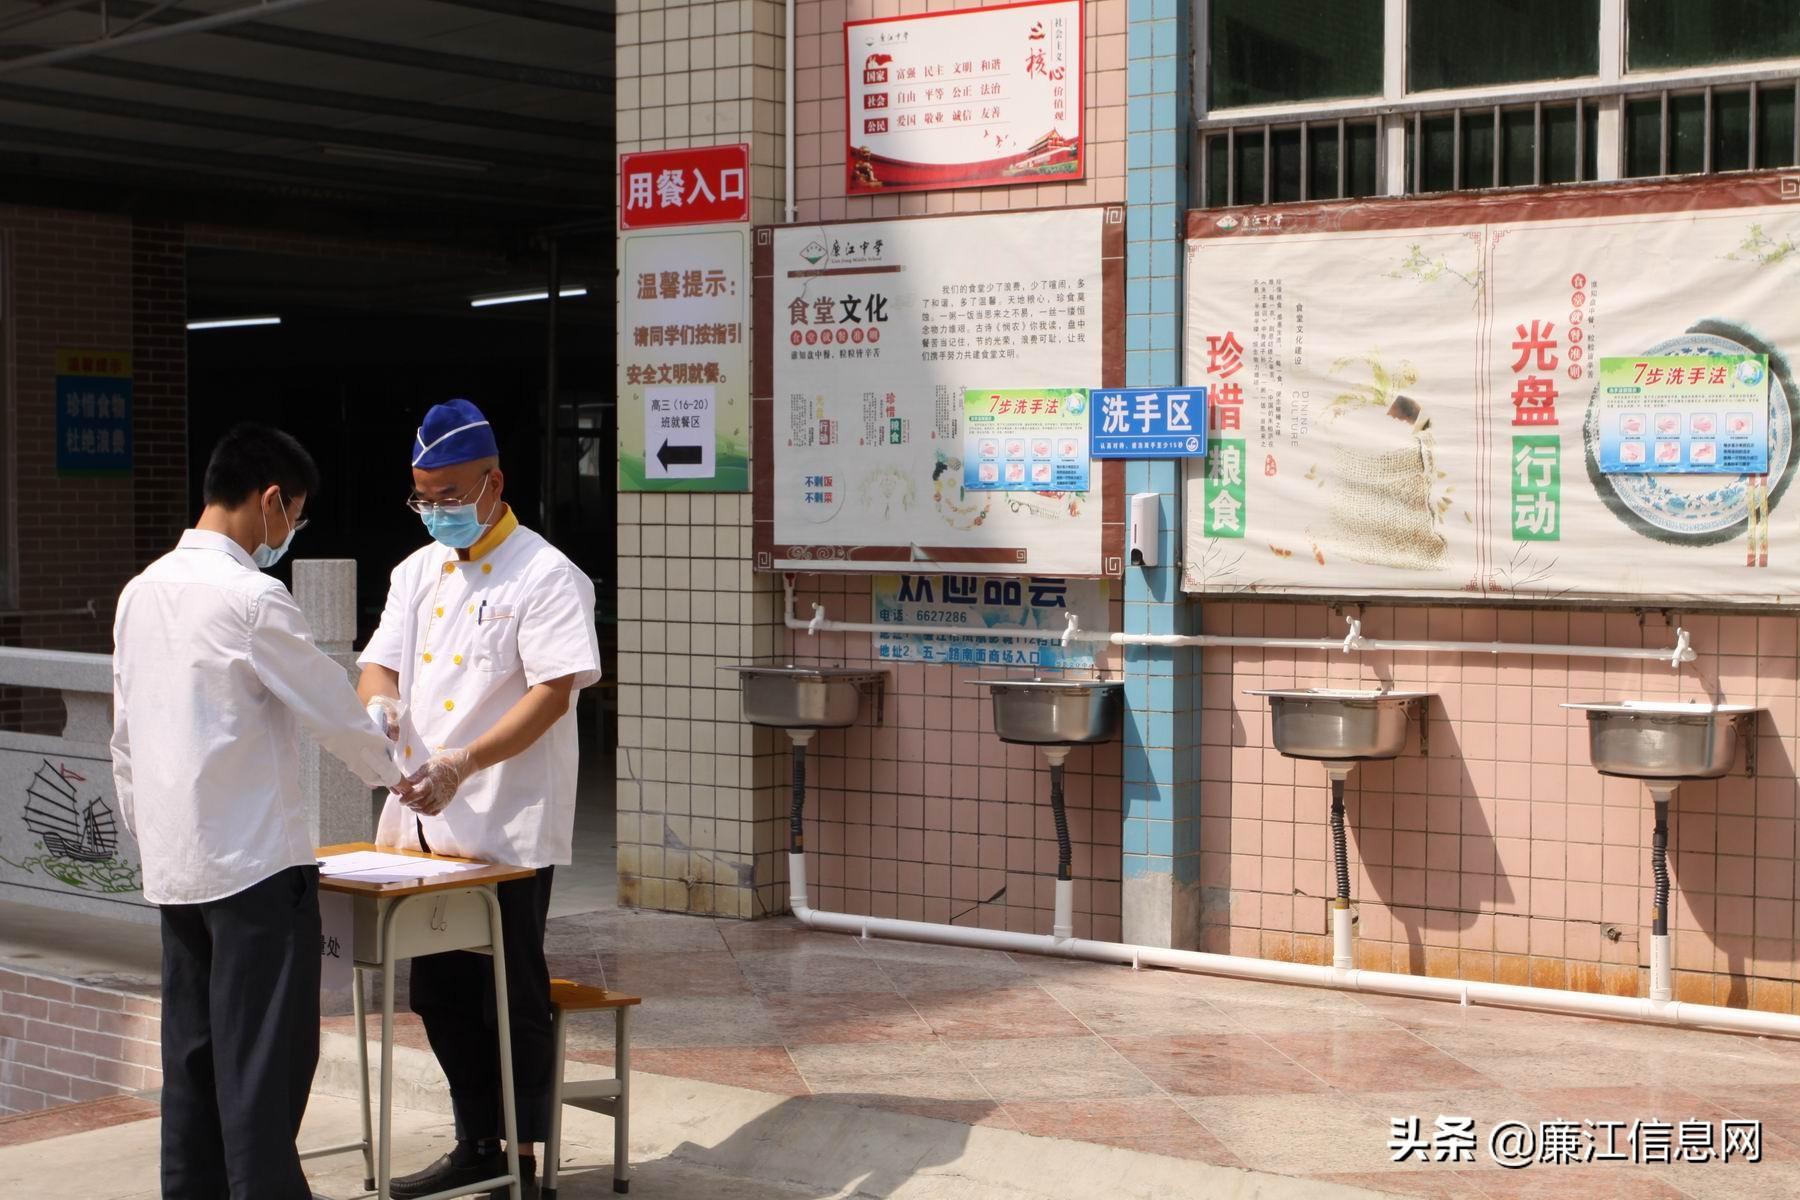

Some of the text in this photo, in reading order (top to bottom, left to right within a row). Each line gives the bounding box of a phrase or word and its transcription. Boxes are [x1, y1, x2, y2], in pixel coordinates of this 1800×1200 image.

[866, 59, 1001, 83] 国家 富强 民主 文明 和谐
[1026, 47, 1065, 81] 核心
[866, 82, 1001, 107] 社会 自由 平等 公正 法治
[866, 106, 1001, 132] 公民 爱国 敬业 诚信 友善
[627, 168, 744, 210] 用餐入口
[787, 293, 888, 326] 食堂文化
[633, 322, 742, 347] 请同学们按指引
[627, 361, 727, 385] 安全文明就餐。
[1206, 330, 1244, 431] 珍惜
[1511, 319, 1559, 427] 光盘
[1632, 363, 1728, 385] 7步洗手法
[65, 391, 126, 419] 珍惜食物
[886, 392, 896, 417] 珍惜
[989, 395, 1059, 414] 7步洗手法
[1102, 393, 1192, 433] 洗手区
[1300, 391, 1310, 435] DINING
[661, 416, 700, 428] 班就餐区
[890, 419, 900, 443] 粮食
[1290, 391, 1300, 447] CULTURE
[65, 426, 126, 455] 杜绝浪费
[805, 476, 832, 487] 不剩饭
[1208, 445, 1242, 531] 粮食
[1514, 443, 1557, 536] 行动
[805, 492, 832, 503] 不剩菜
[916, 610, 967, 623] 6627286
[922, 645, 1040, 664] 五一路南面商场入口
